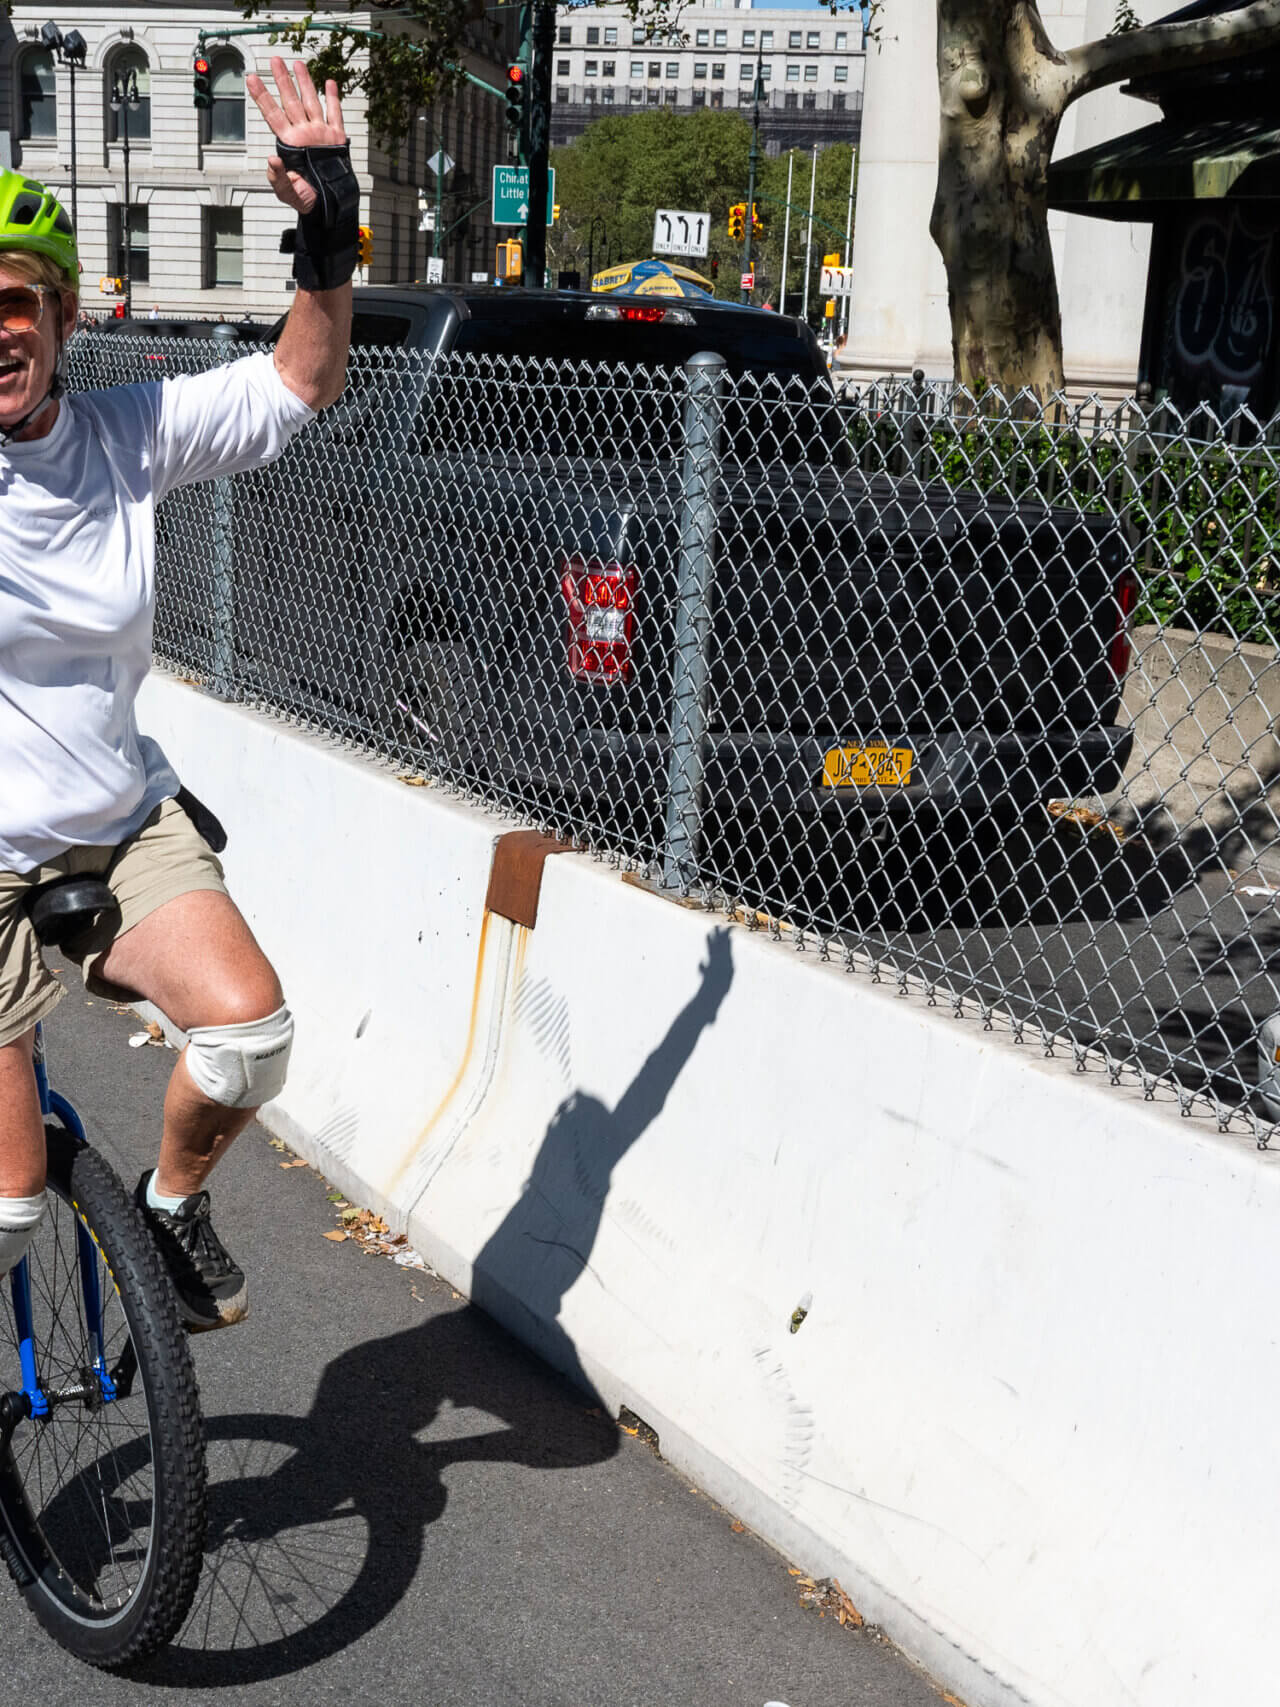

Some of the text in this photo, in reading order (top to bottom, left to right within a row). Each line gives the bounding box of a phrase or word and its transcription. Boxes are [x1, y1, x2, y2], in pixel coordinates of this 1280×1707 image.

[500, 171, 529, 184] Chinat
[500, 187, 524, 199] Little
[673, 244, 688, 252] ONLY
